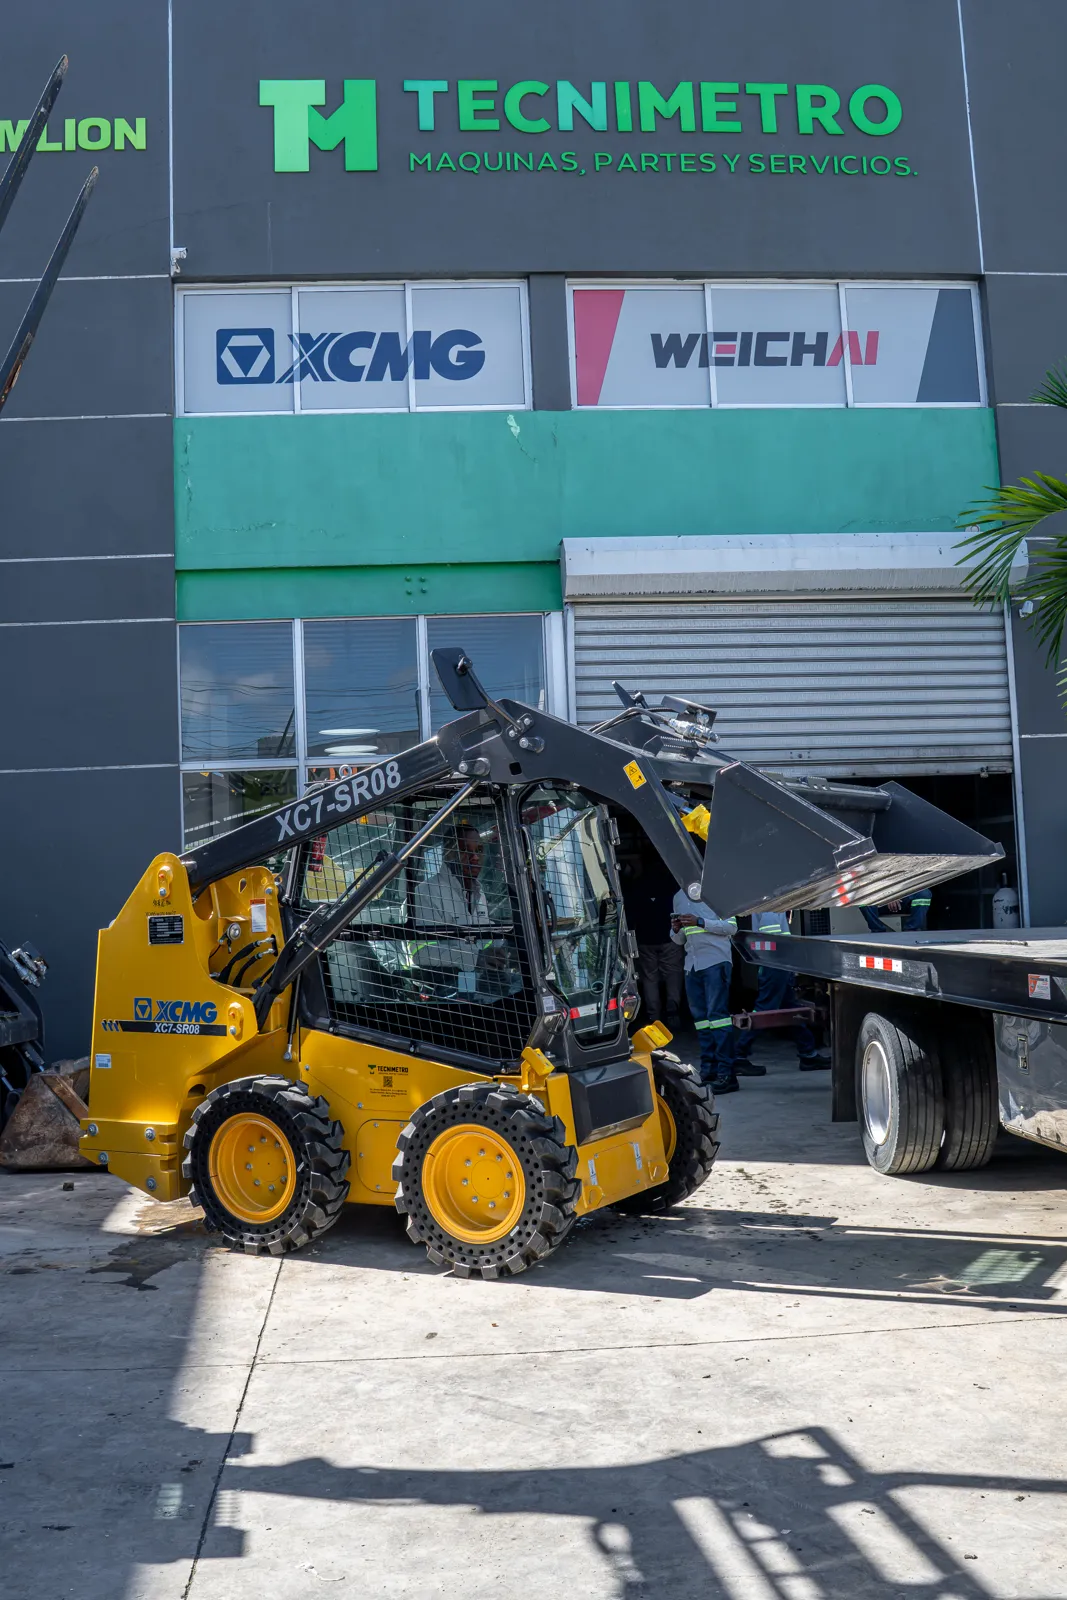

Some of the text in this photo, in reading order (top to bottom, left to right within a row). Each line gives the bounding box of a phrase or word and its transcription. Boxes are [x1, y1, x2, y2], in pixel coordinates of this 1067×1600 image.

[403, 79, 902, 136] TECNIMETRO
[409, 151, 919, 177] MAQUINAS, PARTES Y SERVICIOS.
[275, 328, 486, 384] XCMG
[650, 330, 880, 368] WEICHAI
[275, 761, 402, 842] XC7-SR08
[153, 1000, 218, 1024] XCMG
[153, 1022, 200, 1035] XC7-SR08
[377, 1065, 409, 1073] TECNIMETRO
